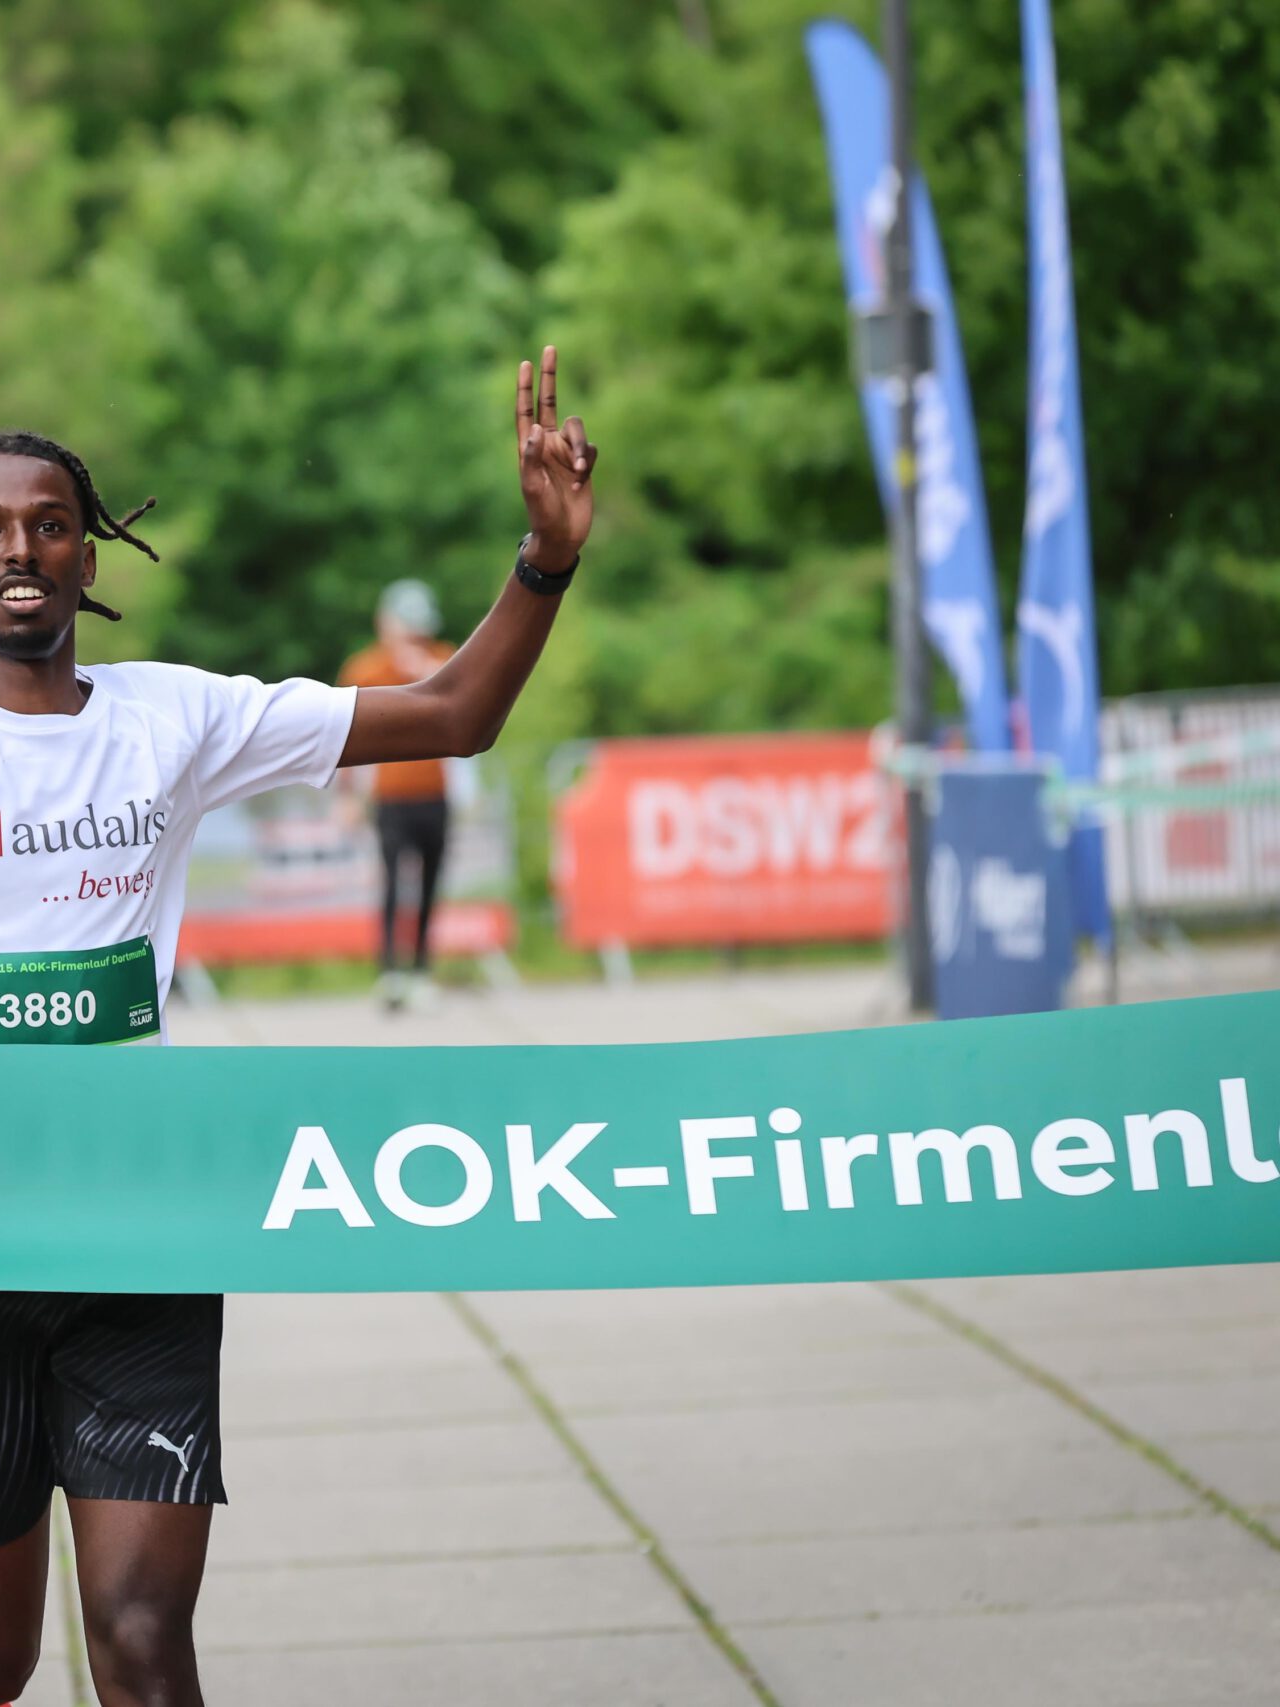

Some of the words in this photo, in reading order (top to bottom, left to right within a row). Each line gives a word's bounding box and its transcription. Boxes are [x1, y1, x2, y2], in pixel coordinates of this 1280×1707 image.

[12, 799, 166, 855] audalis
[20, 956, 109, 973] AOK-Firmenlauf
[112, 946, 147, 964] Dortmund
[137, 1012, 154, 1026] LAUF
[261, 1077, 1280, 1230] AOK-Firmenl
